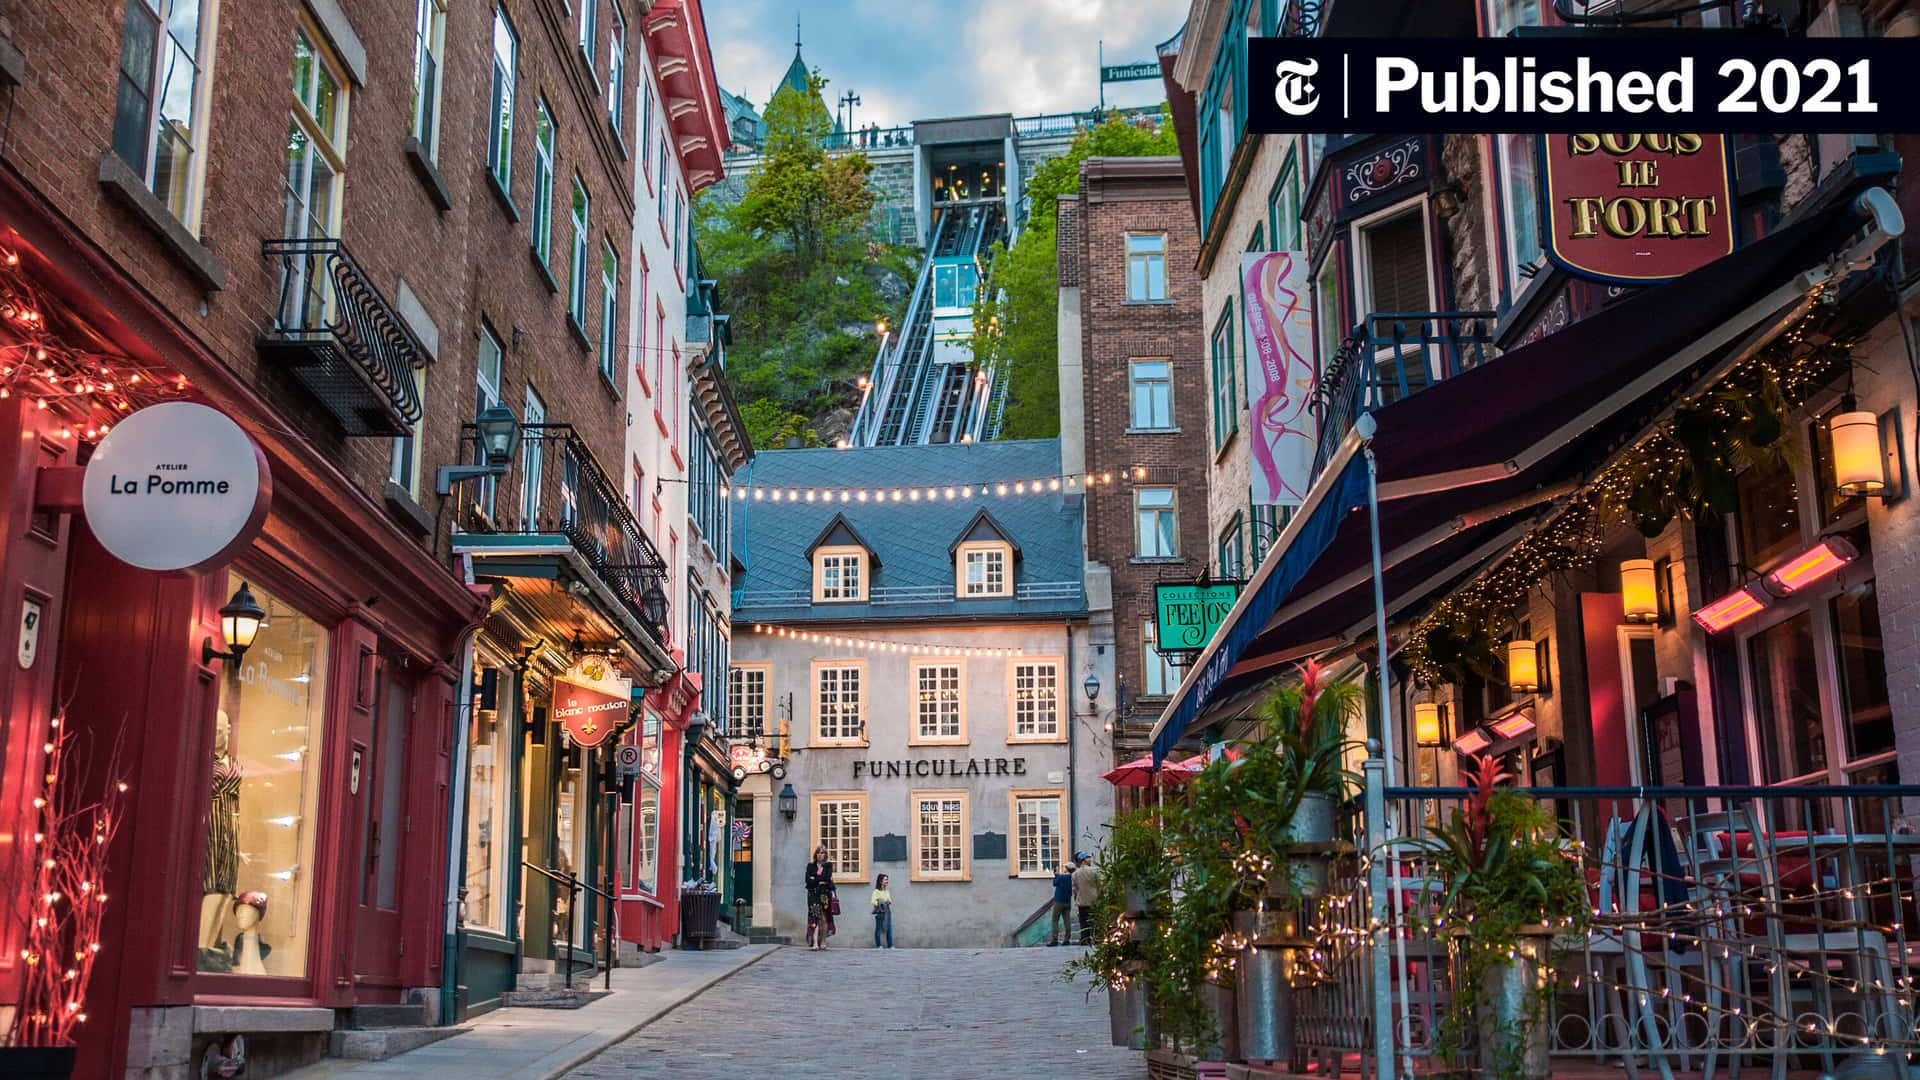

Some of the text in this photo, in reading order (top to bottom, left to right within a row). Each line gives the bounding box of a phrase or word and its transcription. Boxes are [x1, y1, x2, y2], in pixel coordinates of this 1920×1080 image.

[1616, 160, 1659, 187] LE
[1566, 195, 1717, 239] FORT
[1266, 359, 1281, 382] 2008
[110, 474, 230, 495] La Pomme
[1162, 591, 1232, 599] COLLECTIONS
[555, 700, 627, 718] blanc mouton
[853, 757, 1027, 778] FUNICULAIRE
